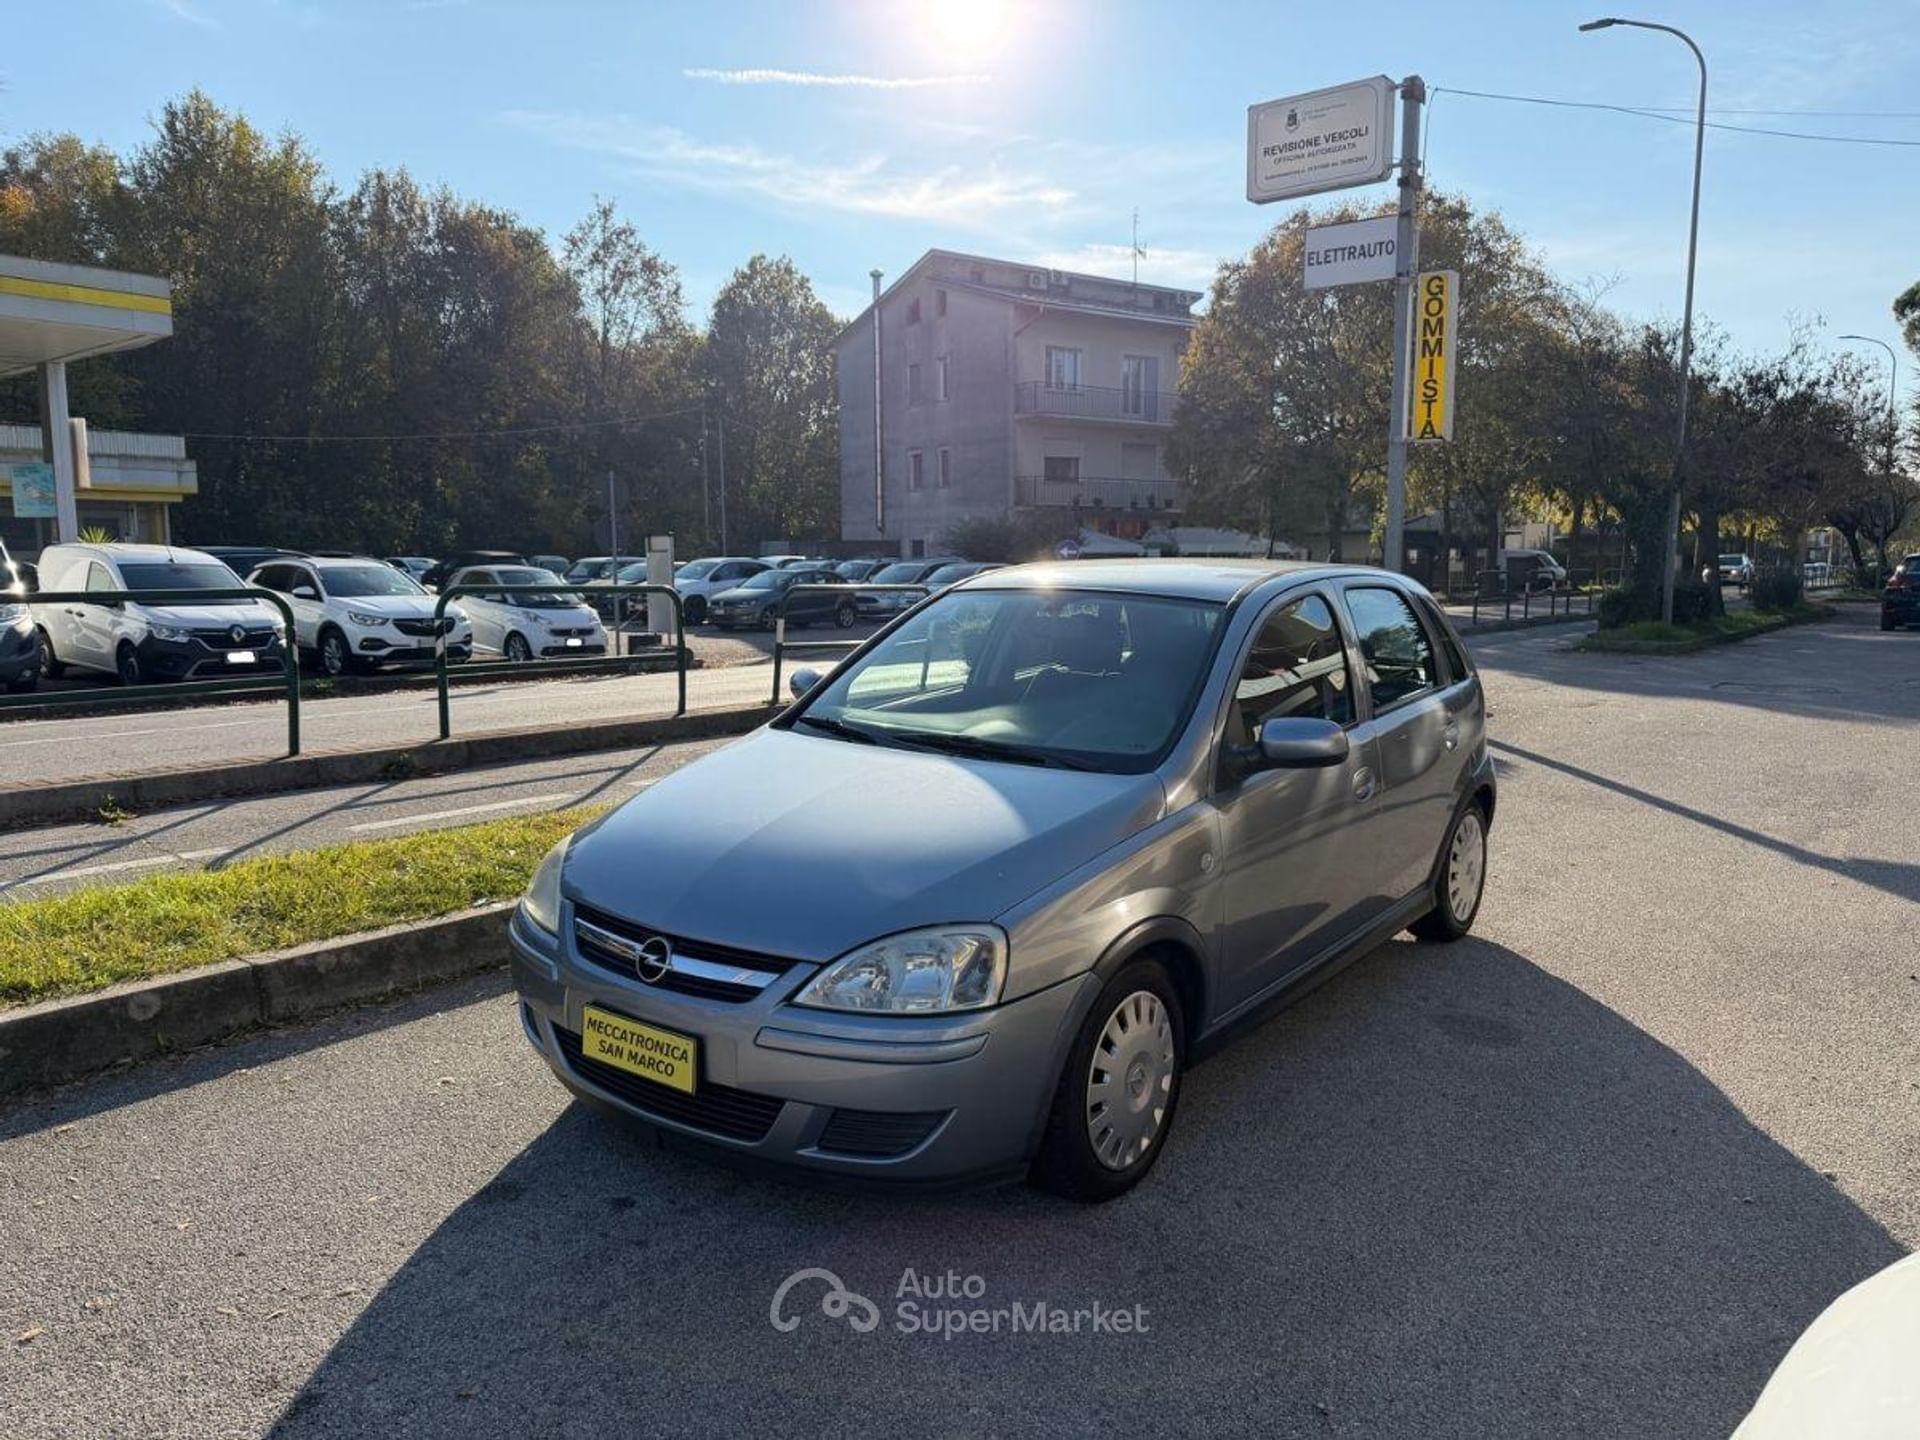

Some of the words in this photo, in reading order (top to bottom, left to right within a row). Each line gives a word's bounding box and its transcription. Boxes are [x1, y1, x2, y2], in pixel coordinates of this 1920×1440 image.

[1263, 136, 1321, 157] REVISIONE
[1323, 126, 1369, 143] VEICOLI
[1307, 239, 1395, 266] ELETTRAUTO
[1420, 275, 1444, 439] GOMMISTA
[587, 1017, 689, 1063] MECCATRONICA
[598, 1039, 624, 1059] SAN
[627, 1050, 675, 1077] MARCO
